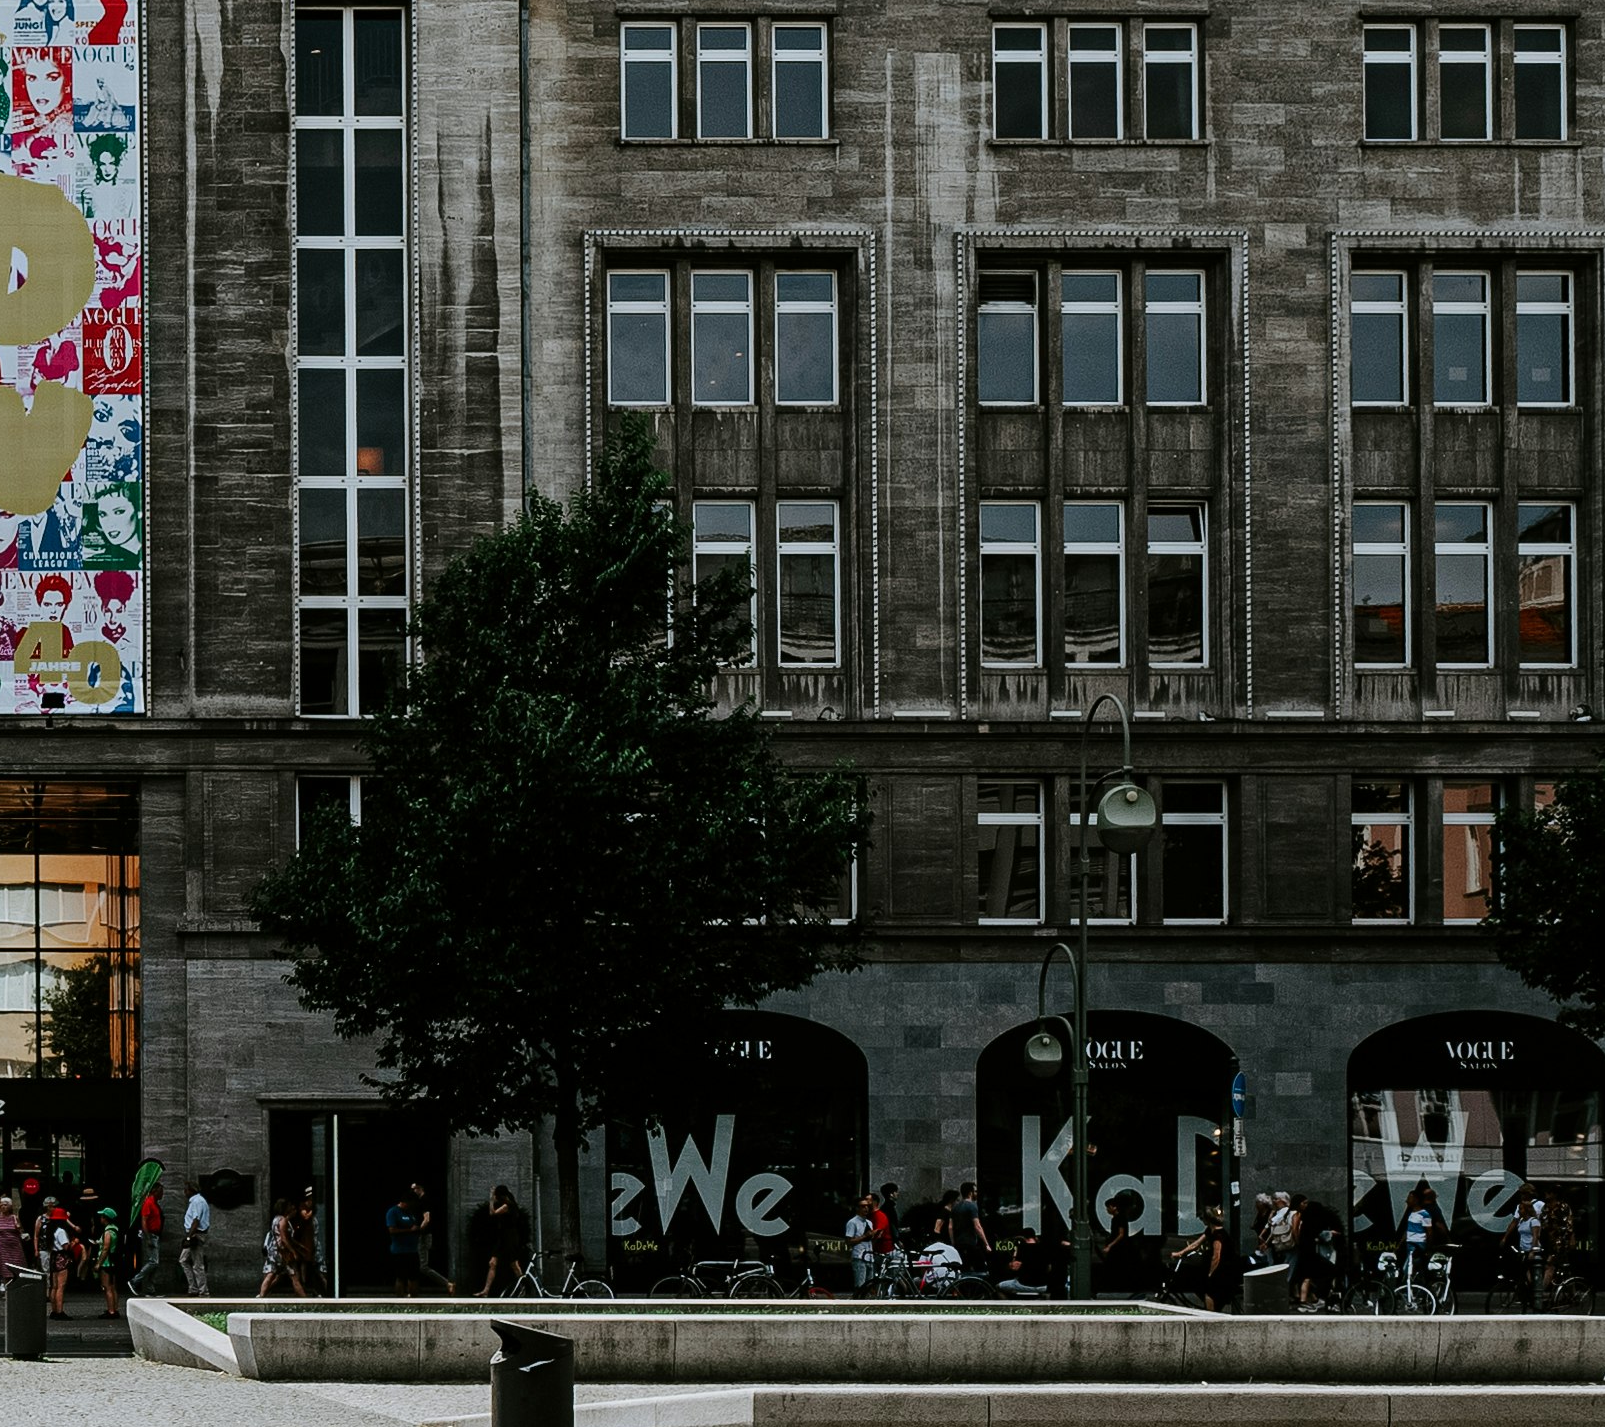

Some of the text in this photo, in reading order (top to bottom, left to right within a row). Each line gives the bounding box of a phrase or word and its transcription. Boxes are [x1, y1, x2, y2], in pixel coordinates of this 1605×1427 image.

[12, 46, 73, 65] VOGUE
[73, 46, 135, 64] VOGUE
[22, 551, 78, 560] CHAMPIONS
[32, 559, 69, 568] LEAGUE
[83, 610, 99, 624] 10
[13, 621, 122, 705] 40
[29, 661, 81, 672] JAHRE
[1085, 1040, 1144, 1060] OGUE
[1445, 1040, 1515, 1061] VOGUE
[623, 1240, 659, 1251] KaDeWe
